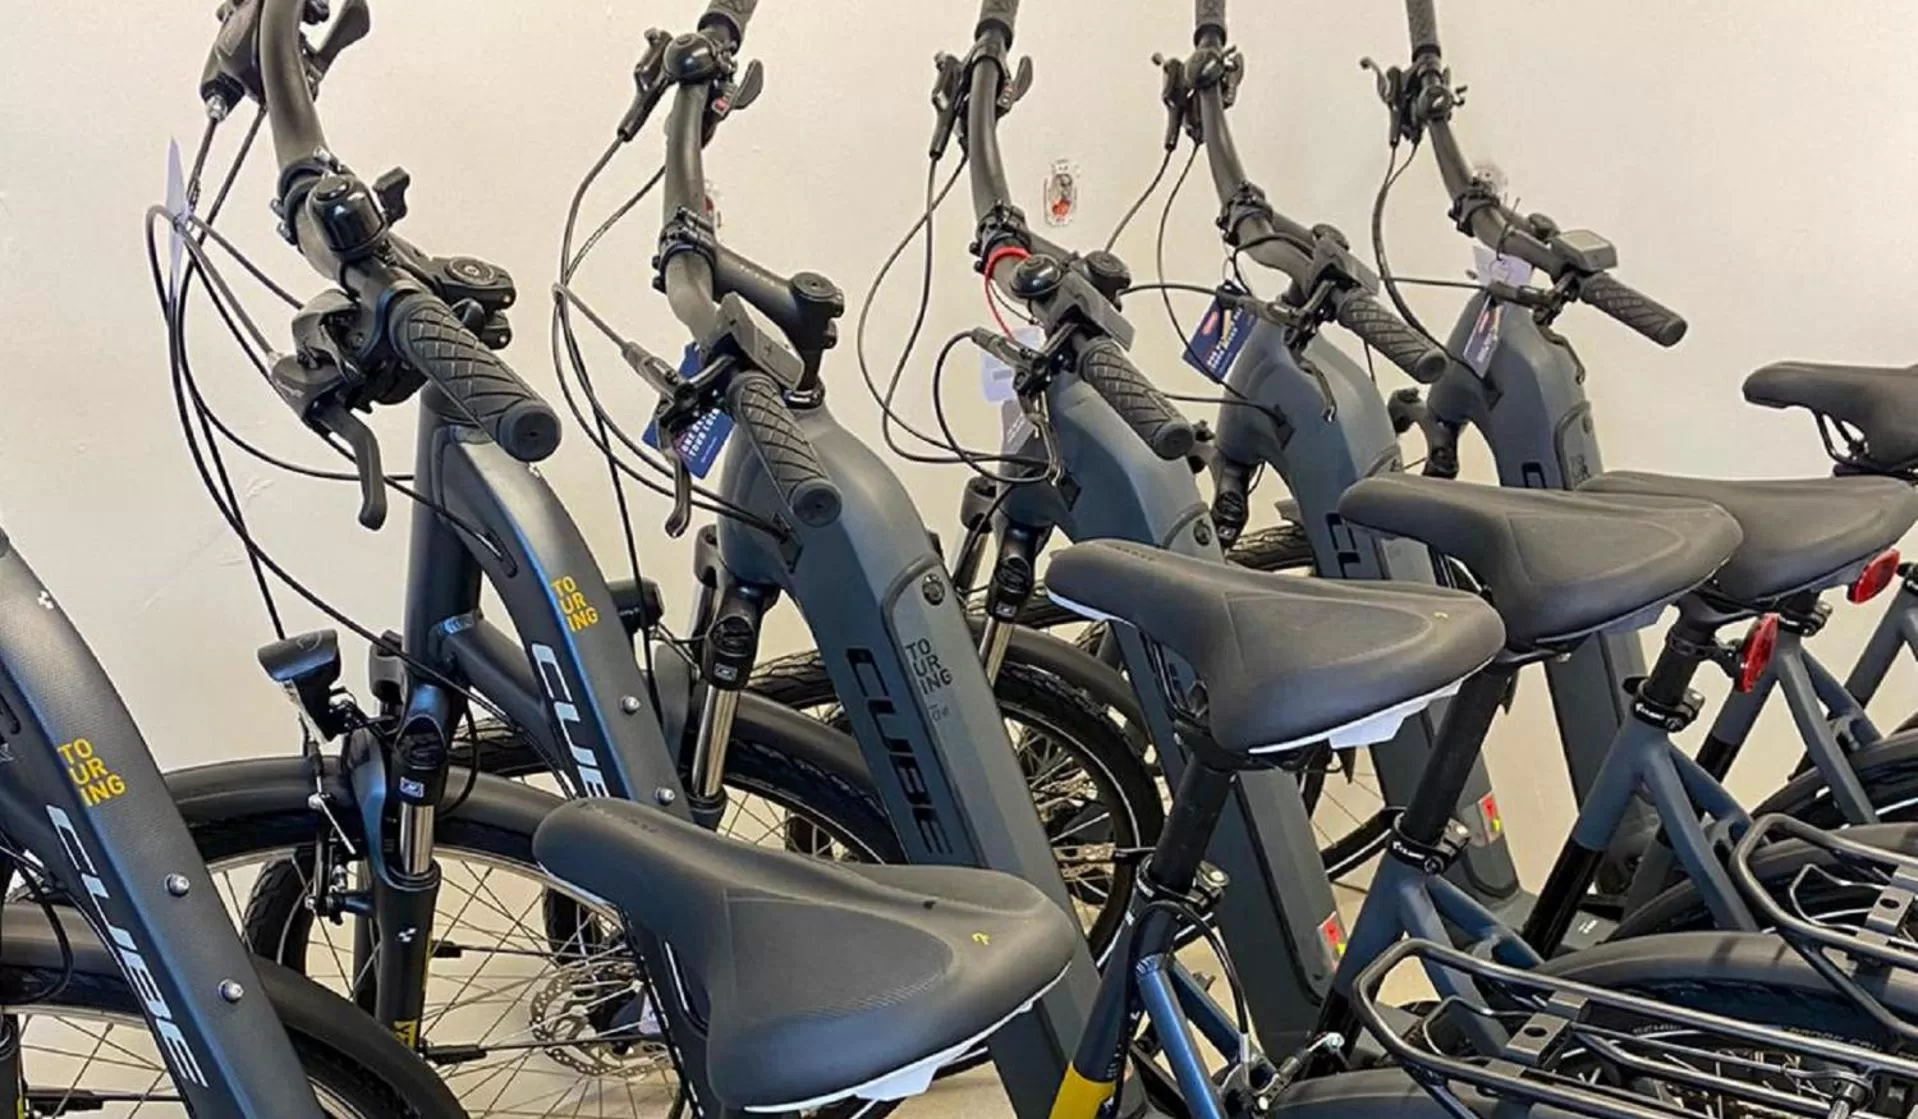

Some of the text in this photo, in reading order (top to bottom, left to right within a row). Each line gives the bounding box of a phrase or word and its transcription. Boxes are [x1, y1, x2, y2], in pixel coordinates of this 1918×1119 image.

[551, 575, 577, 597] TO
[559, 592, 587, 615] UR
[566, 606, 599, 632] ING
[905, 638, 932, 661] TO
[913, 654, 941, 677] UR
[920, 668, 953, 695] ING
[56, 738, 93, 764] TO
[846, 647, 953, 854] CUBE
[69, 757, 108, 785] UR
[81, 773, 126, 807] ING
[46, 804, 209, 1088] CUBE
